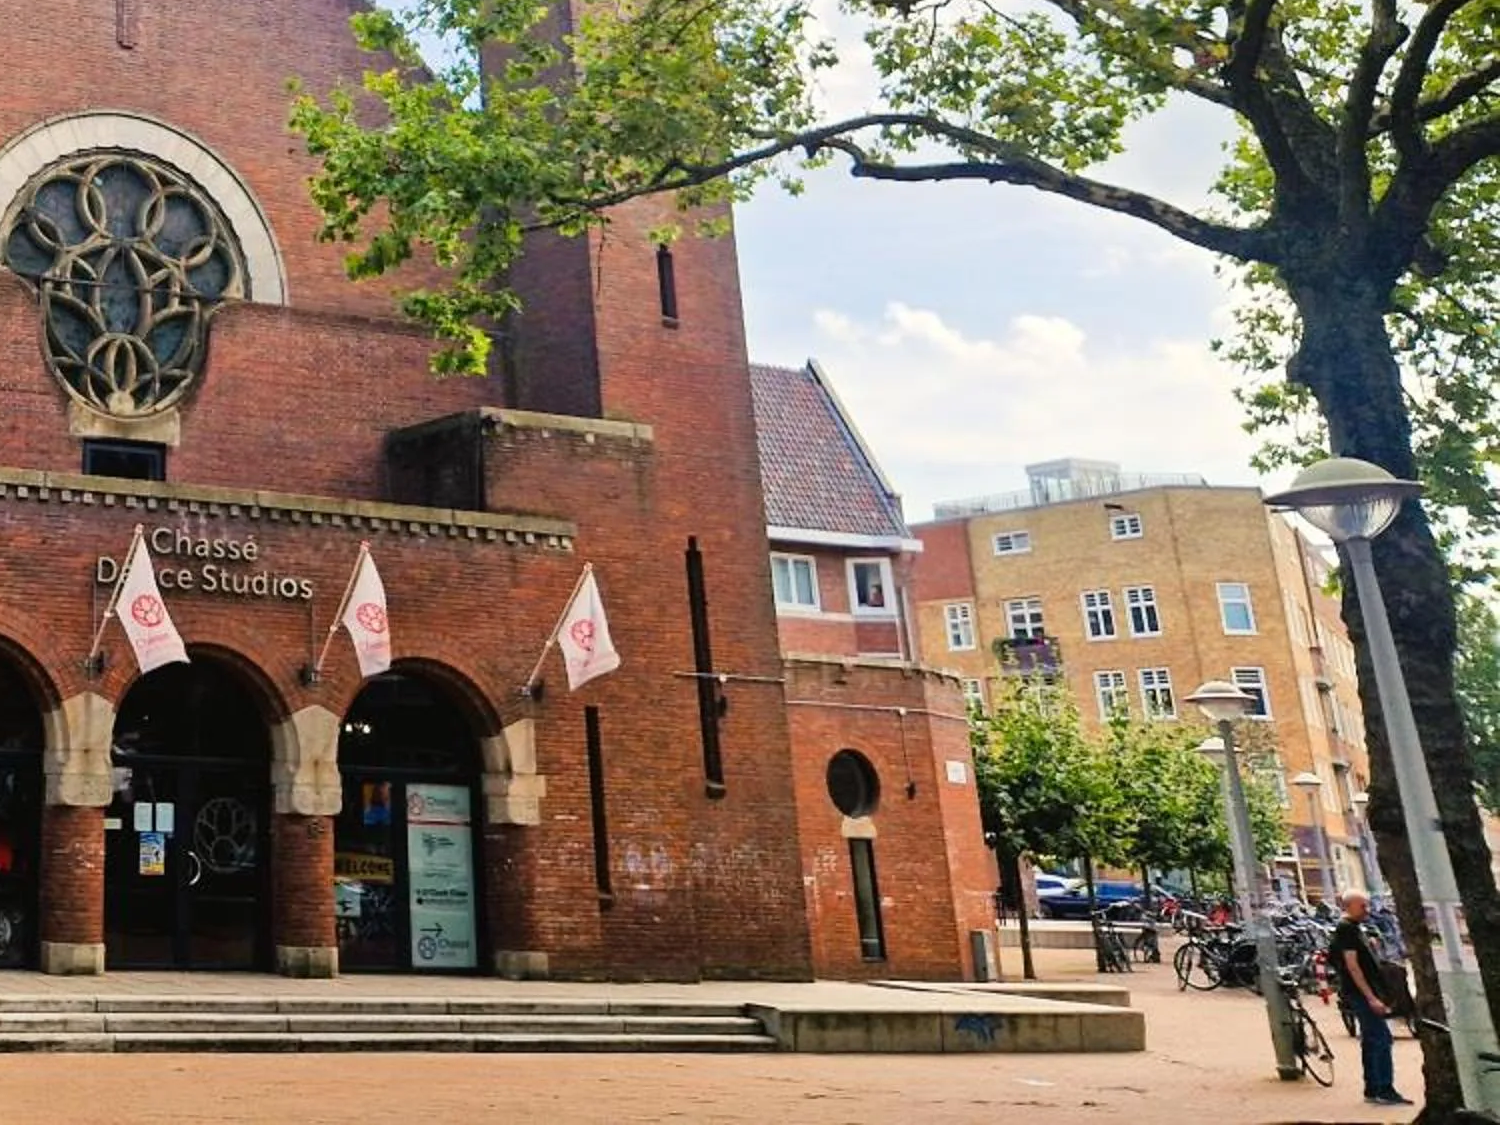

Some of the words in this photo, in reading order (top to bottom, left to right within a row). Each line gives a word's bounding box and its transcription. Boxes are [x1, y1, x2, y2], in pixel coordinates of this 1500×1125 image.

[151, 527, 259, 561] Chassé
[97, 556, 193, 589] Dce
[202, 564, 313, 599] Studios
